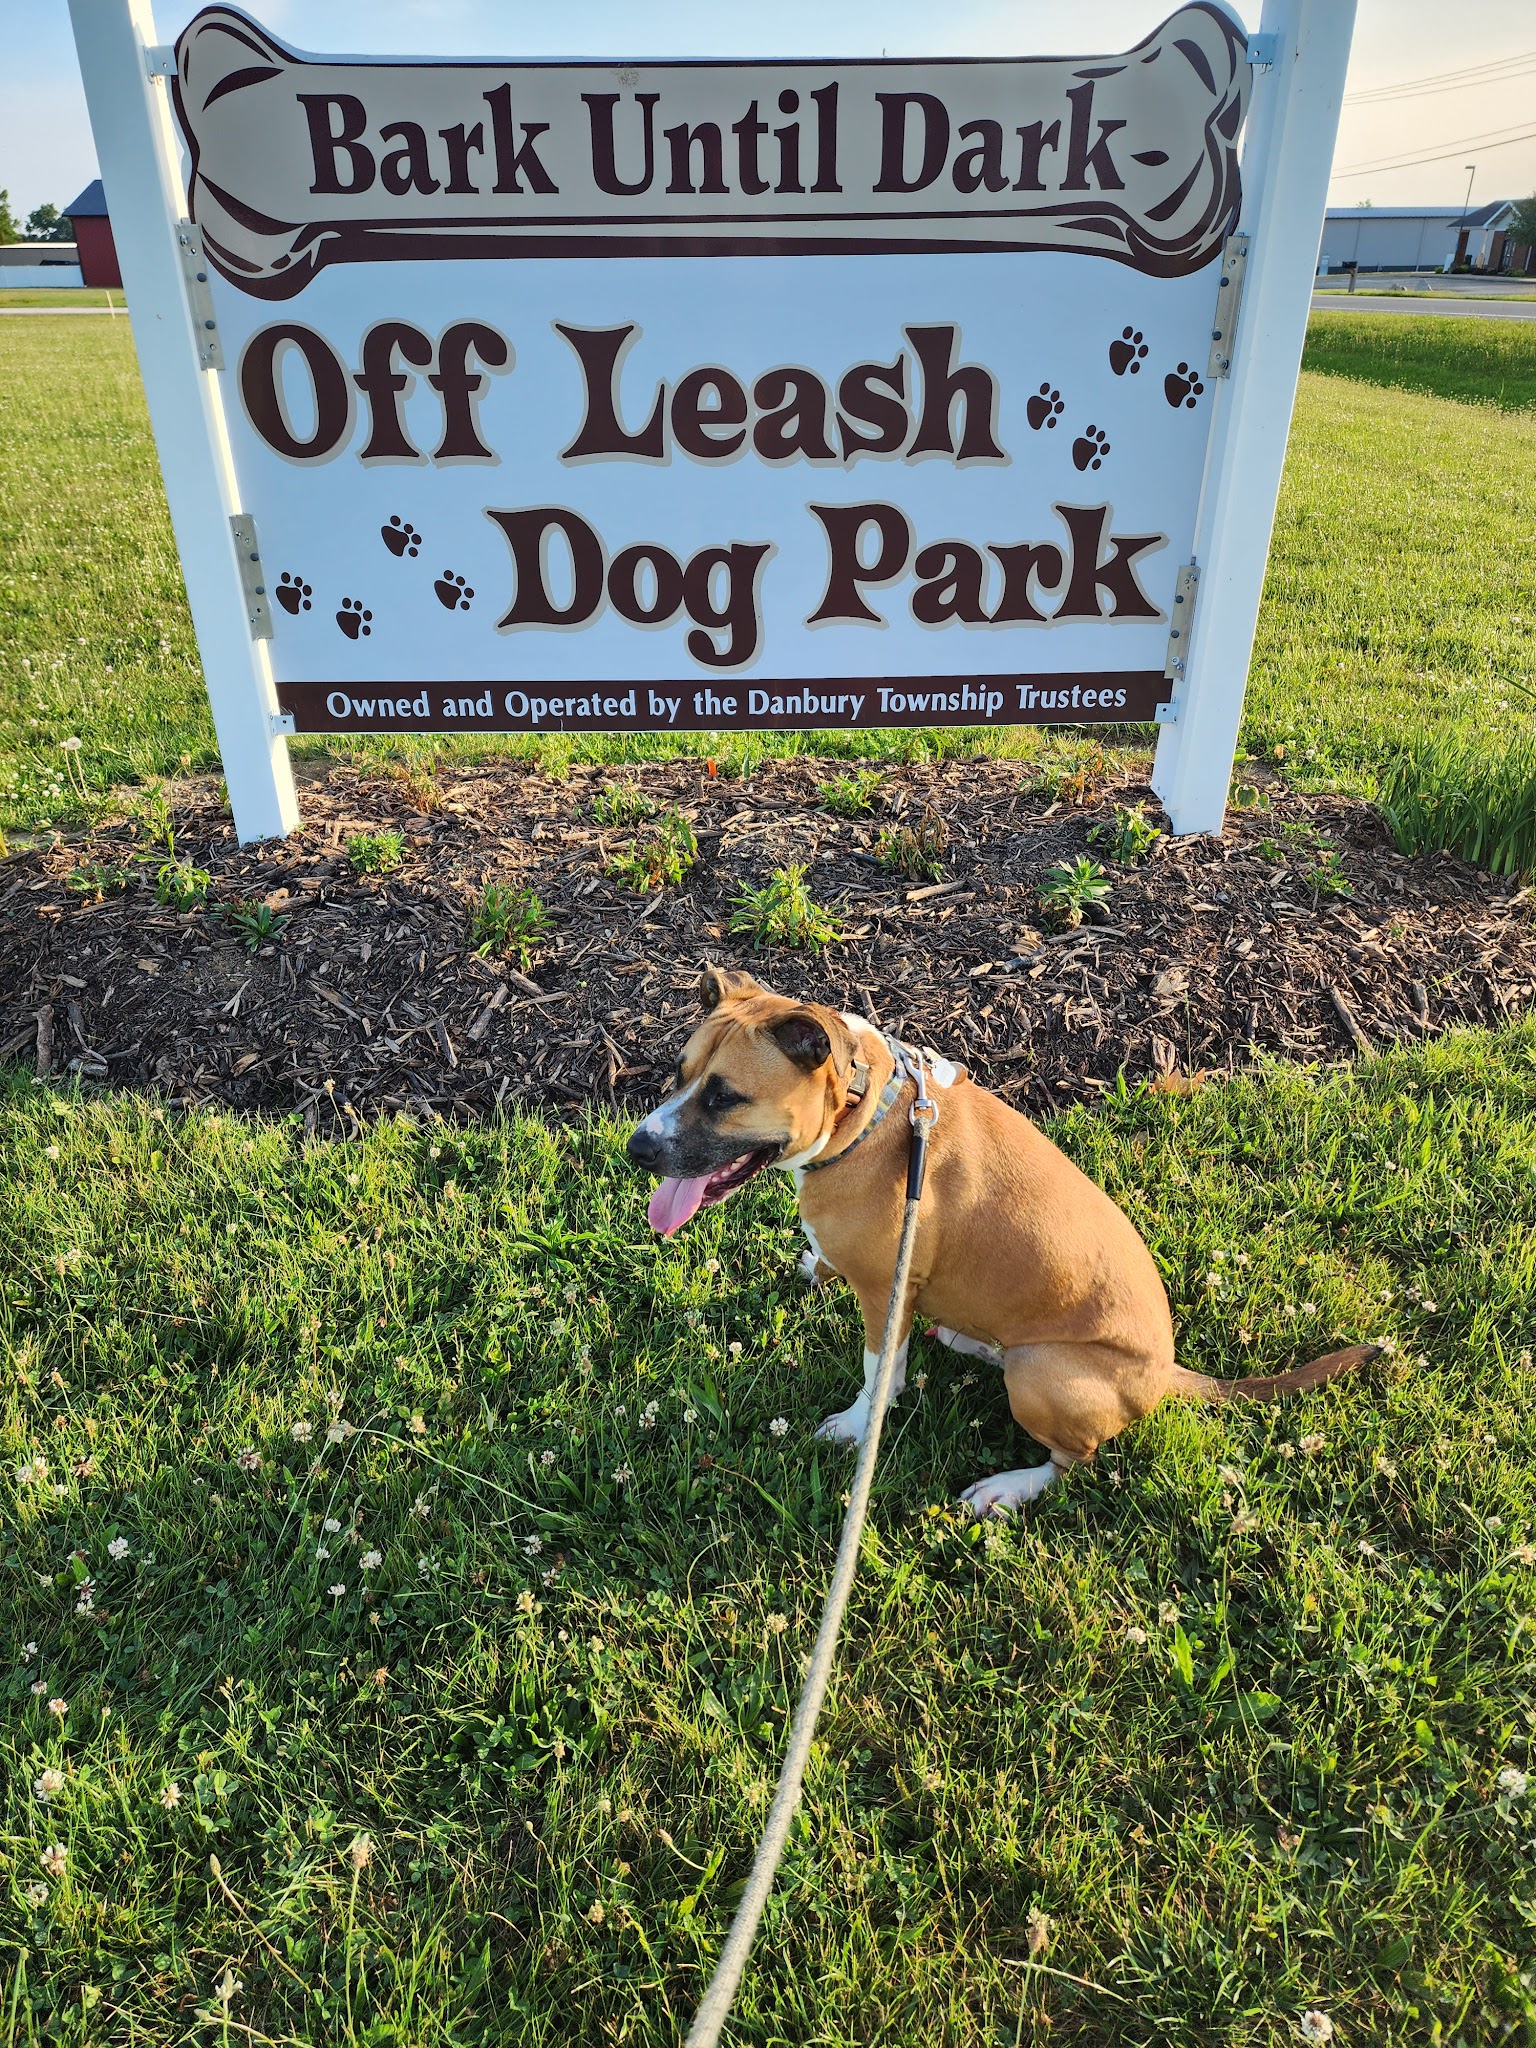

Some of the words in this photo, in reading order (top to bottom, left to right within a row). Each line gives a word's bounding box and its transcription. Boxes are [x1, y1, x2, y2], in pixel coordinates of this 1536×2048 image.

[296, 81, 560, 196] Bark
[581, 81, 843, 196] Until
[873, 79, 1128, 194] Dark
[241, 322, 508, 462] Off
[554, 322, 1005, 463] Leash
[486, 507, 771, 667] Dog
[806, 502, 1163, 625] Park
[326, 690, 431, 718] Owned
[442, 690, 494, 717] and
[504, 689, 637, 724] Operated
[648, 689, 682, 723] by
[693, 689, 738, 716] the
[748, 687, 866, 721] Danbury
[876, 683, 1004, 718] Township
[1015, 684, 1128, 710] Trustees
